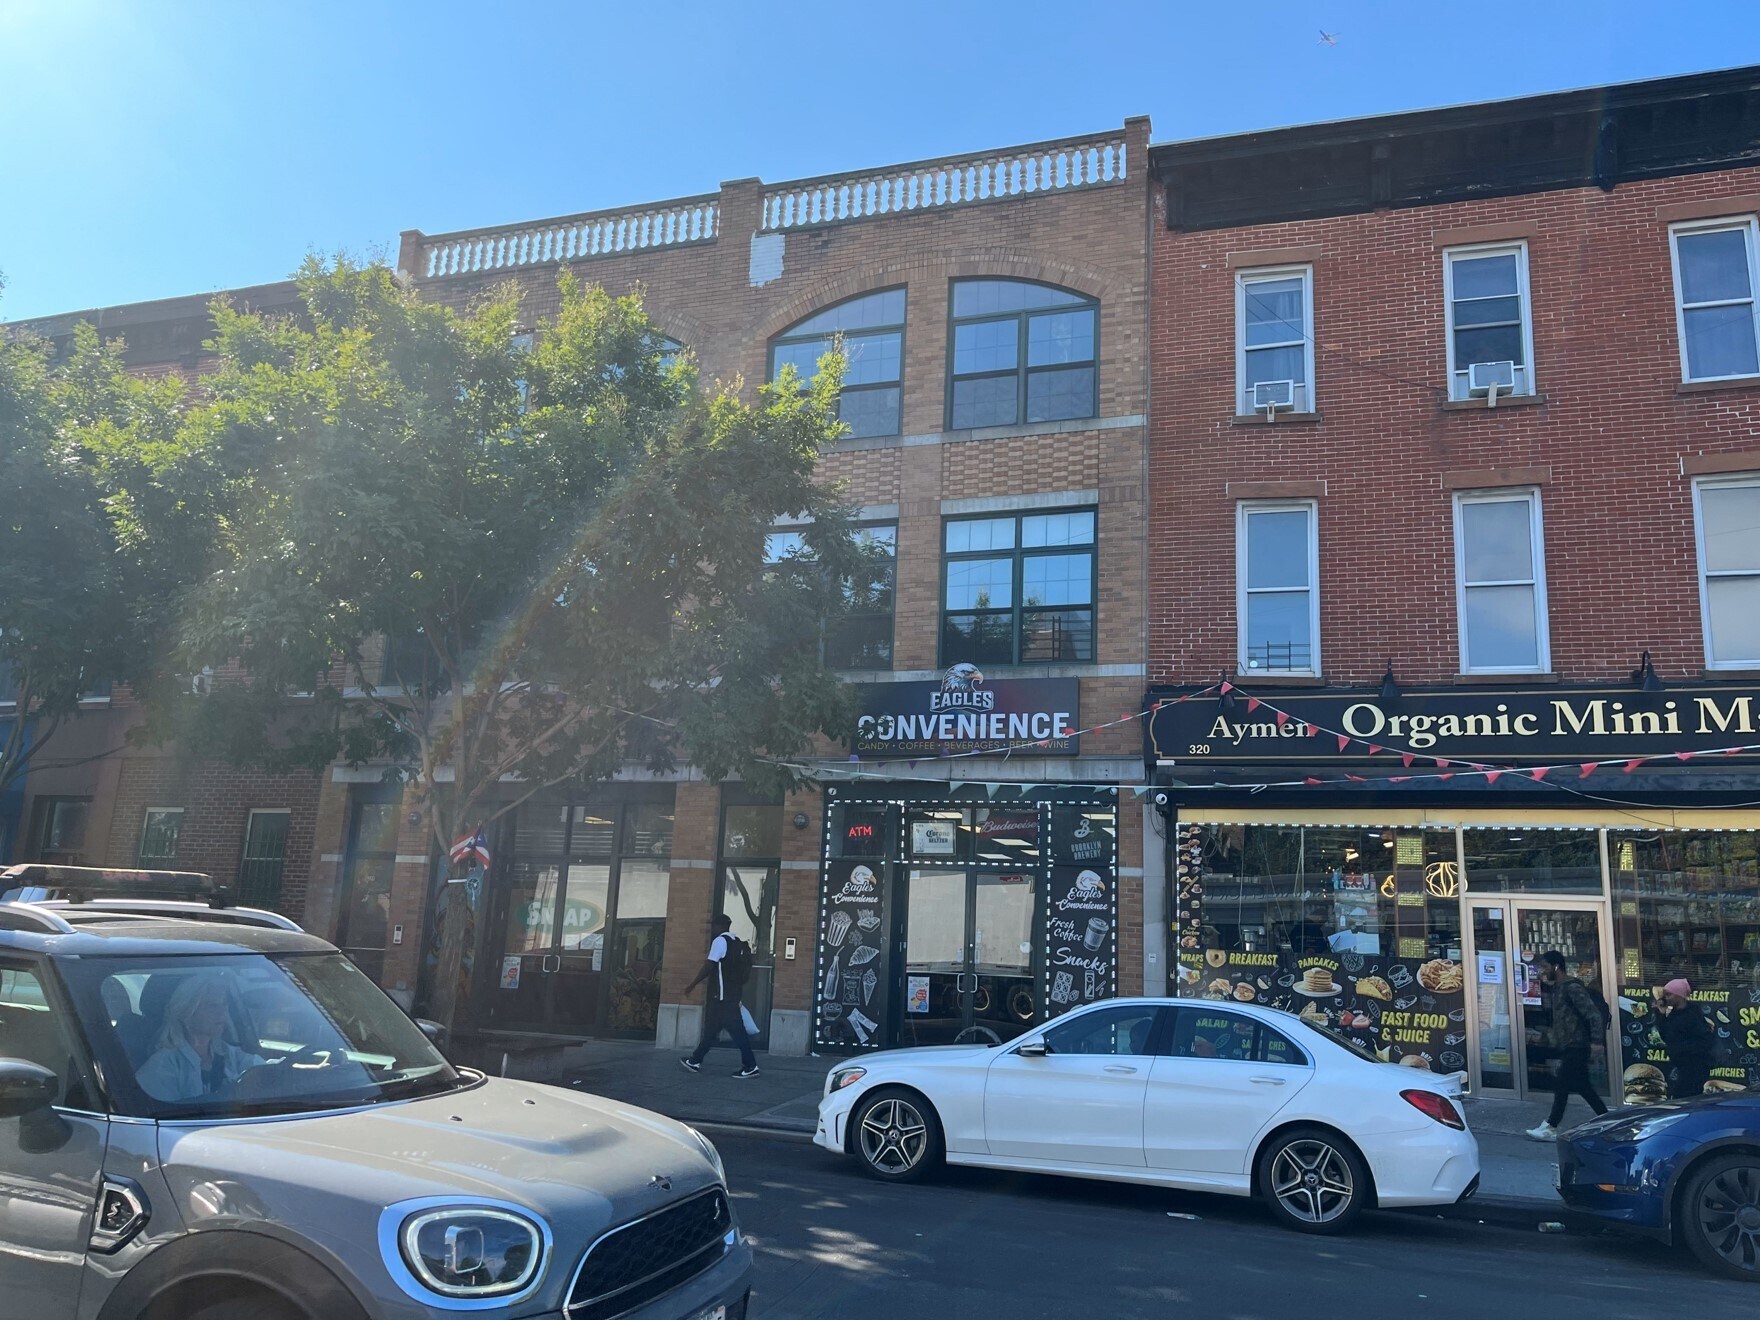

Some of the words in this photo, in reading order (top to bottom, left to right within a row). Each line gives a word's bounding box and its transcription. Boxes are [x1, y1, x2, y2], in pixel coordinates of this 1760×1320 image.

[932, 691, 993, 710] EAGLES
[857, 712, 1070, 741] CONVENIENCE
[1342, 702, 1540, 748] Organic
[1549, 700, 1683, 735] Mini
[1693, 696, 1760, 734] M
[1206, 714, 1312, 746] Aymen
[857, 741, 890, 750] CANDY
[898, 741, 935, 750] COFFEE
[1009, 740, 1033, 750] BEER
[1188, 744, 1211, 755] 320
[848, 826, 873, 838] ATM
[981, 819, 1039, 833] Budweise
[925, 830, 950, 838] Corona
[1070, 840, 1102, 853] BROOKLYN
[1073, 850, 1102, 860] BREWERY
[842, 881, 874, 895] Eagles
[1067, 887, 1103, 901] Eagles
[831, 893, 879, 904] Convenience
[1055, 898, 1109, 911] Convenience
[1049, 917, 1075, 930] Fresh
[1053, 928, 1083, 942] Coffee
[1053, 946, 1109, 976] Snacks
[1180, 953, 1204, 962] WRAPS
[1228, 952, 1278, 966] BREAKFAST
[1298, 957, 1339, 971] PANCAKES
[1624, 988, 1650, 998] WRAPS
[1380, 1011, 1411, 1027] FAST
[1413, 1012, 1448, 1030] FOOD
[1380, 1027, 1392, 1041] &
[1394, 1028, 1431, 1044] JUICE
